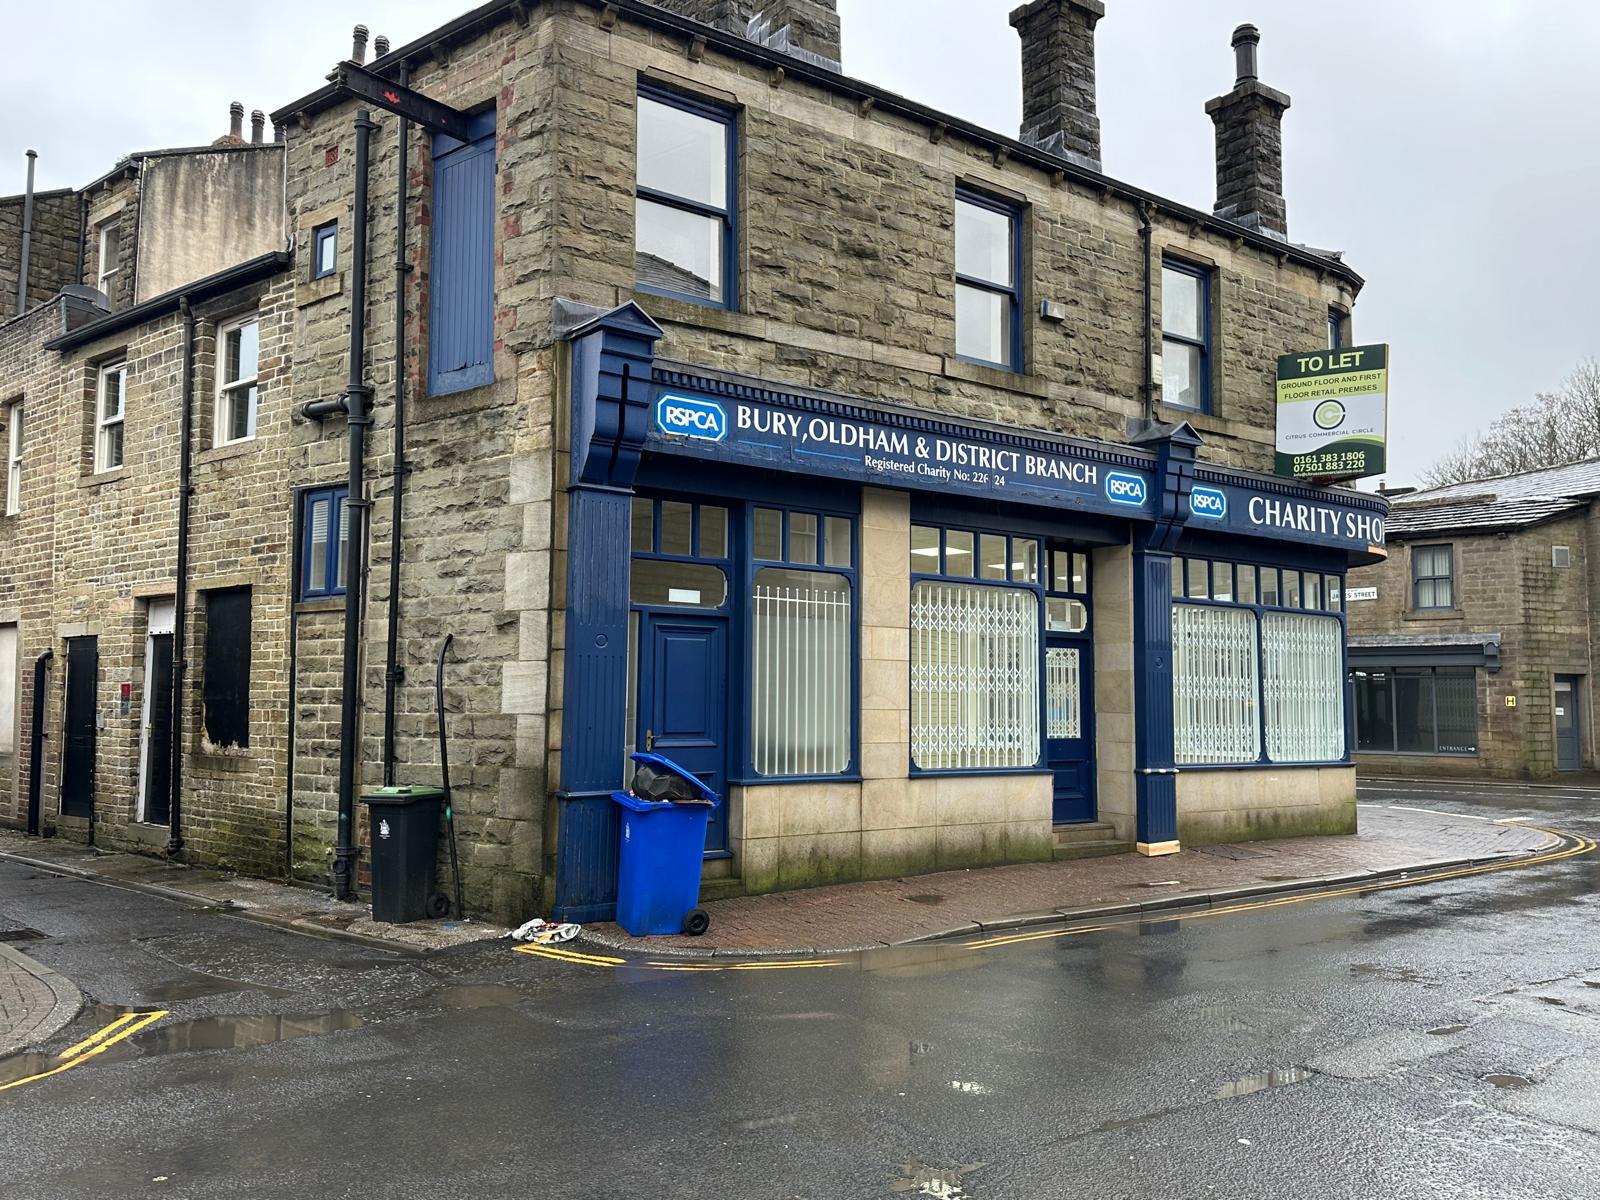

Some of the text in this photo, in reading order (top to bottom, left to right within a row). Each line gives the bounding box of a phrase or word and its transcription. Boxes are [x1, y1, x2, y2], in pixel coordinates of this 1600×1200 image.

[1297, 351, 1364, 372] TO LET
[1280, 373, 1382, 390] GROUND FLOOR AND FIRST
[1284, 384, 1378, 400] FLOOR RETAIL PREMISES
[666, 406, 718, 432] RSPCA
[1308, 430, 1349, 438] COMMERCIAL
[914, 436, 930, 459] &
[936, 439, 1020, 473] DISTRICT
[1026, 455, 1097, 484] BRANCH
[1294, 451, 1365, 464] 0161 383 1806
[1294, 460, 1365, 472] 07501 883 220
[864, 454, 915, 474] Registered
[917, 464, 951, 482] Charity
[954, 470, 970, 482] No:
[1110, 479, 1142, 498] RSPCA
[1193, 494, 1222, 511] RSPCA
[1248, 496, 1342, 536] CHARITY
